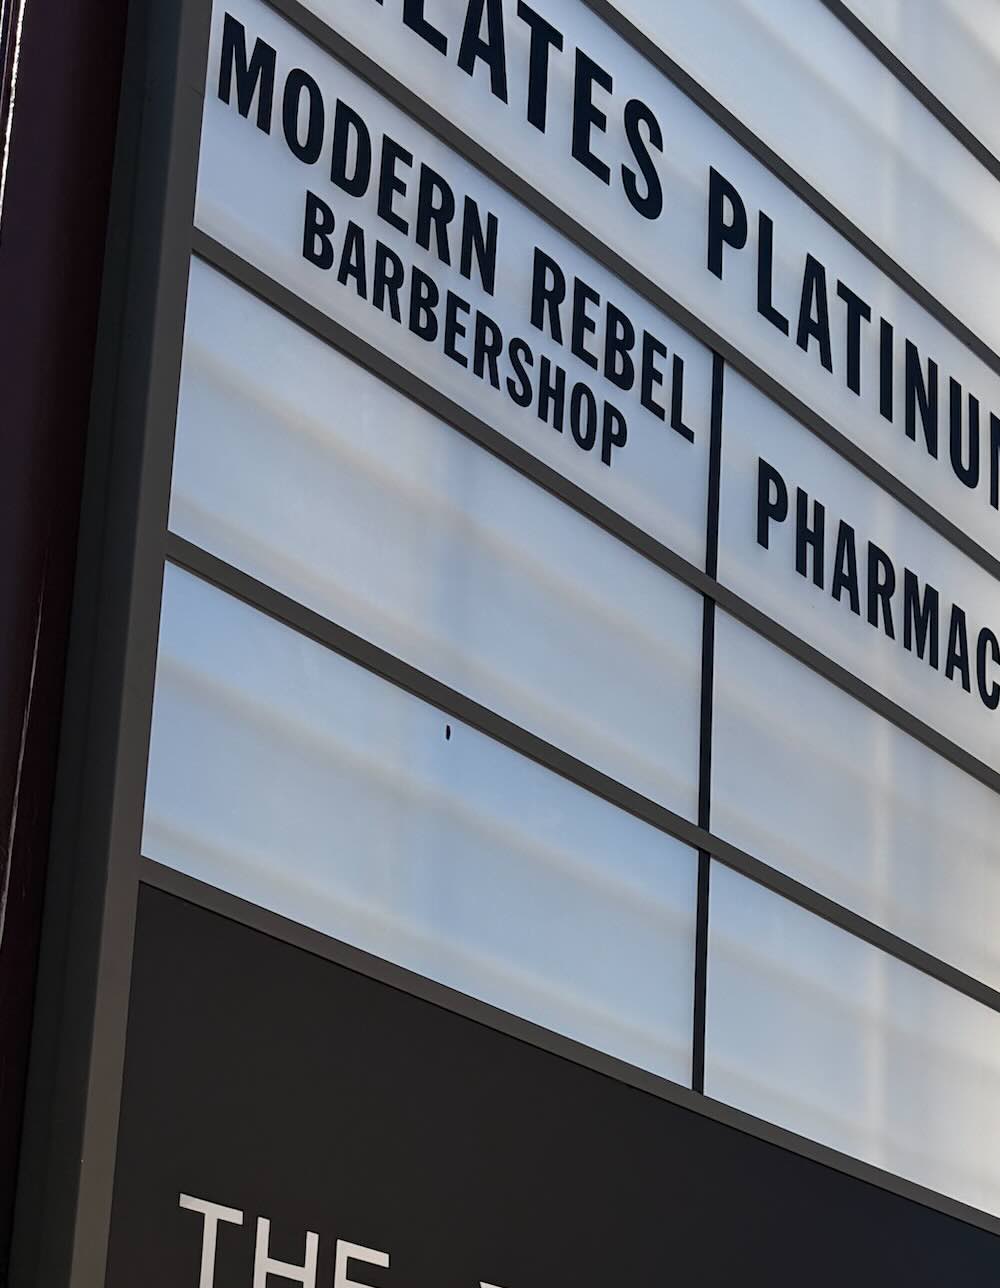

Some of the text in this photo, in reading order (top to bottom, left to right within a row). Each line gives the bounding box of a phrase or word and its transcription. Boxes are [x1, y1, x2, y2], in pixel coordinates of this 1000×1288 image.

[217, 11, 695, 443] MODERN REBEL
[374, 0, 663, 220] ATES
[302, 190, 628, 467] BARBERSHOP
